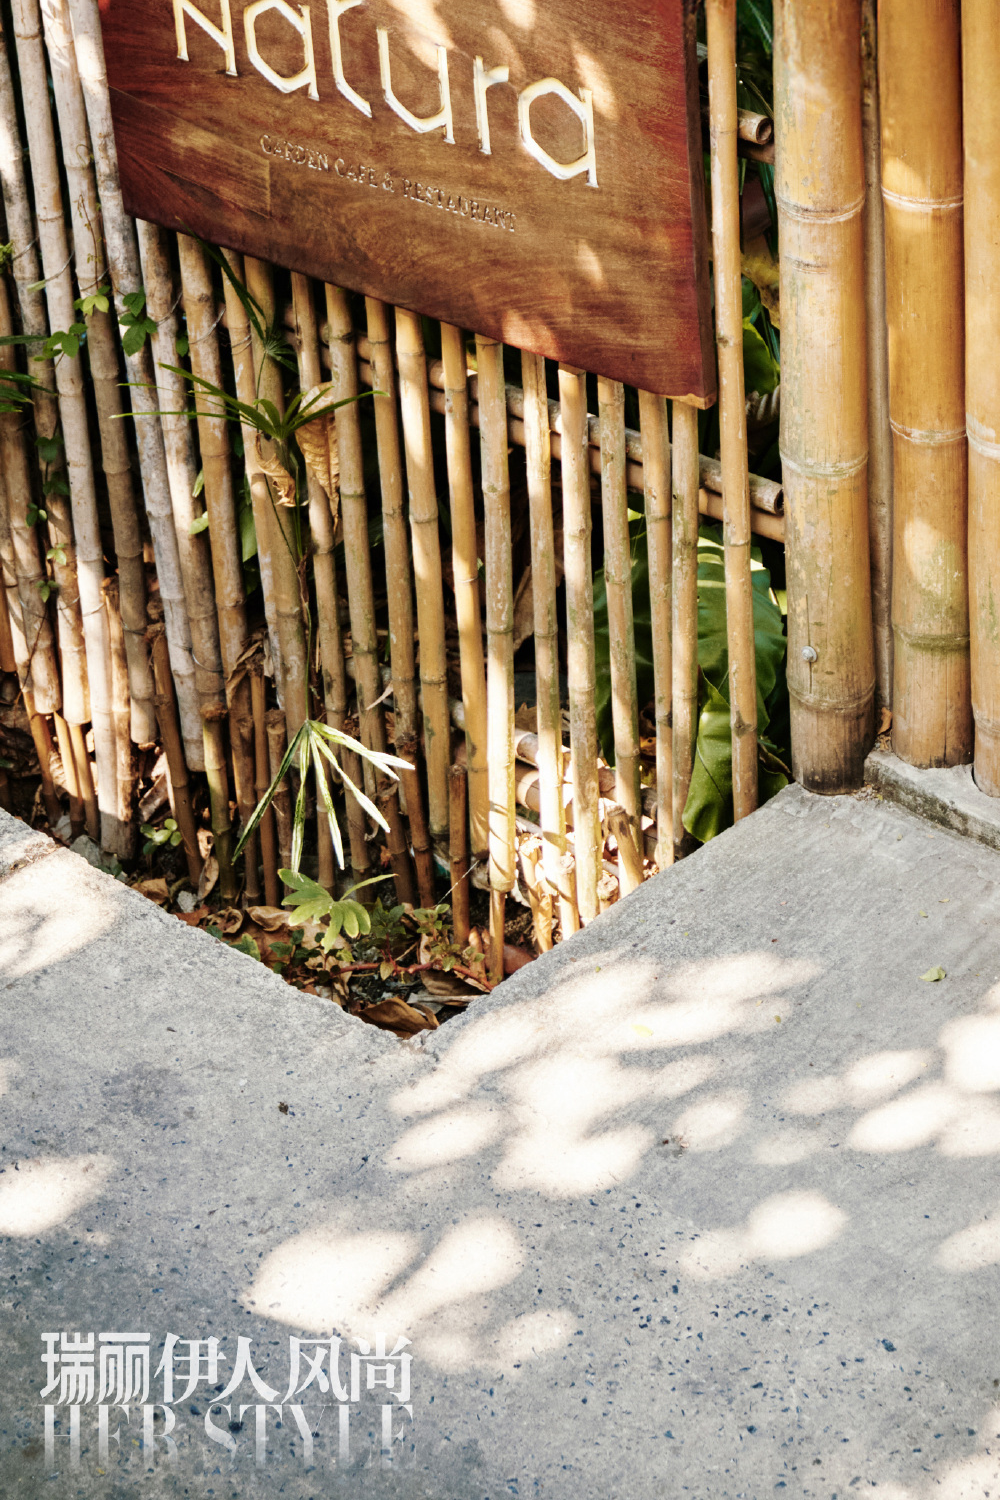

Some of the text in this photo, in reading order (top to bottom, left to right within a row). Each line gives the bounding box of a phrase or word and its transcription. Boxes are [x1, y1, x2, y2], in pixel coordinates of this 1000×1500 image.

[260, 134, 329, 172] GARDEN
[382, 172, 395, 193] &
[401, 178, 516, 232] RESTAURANT
